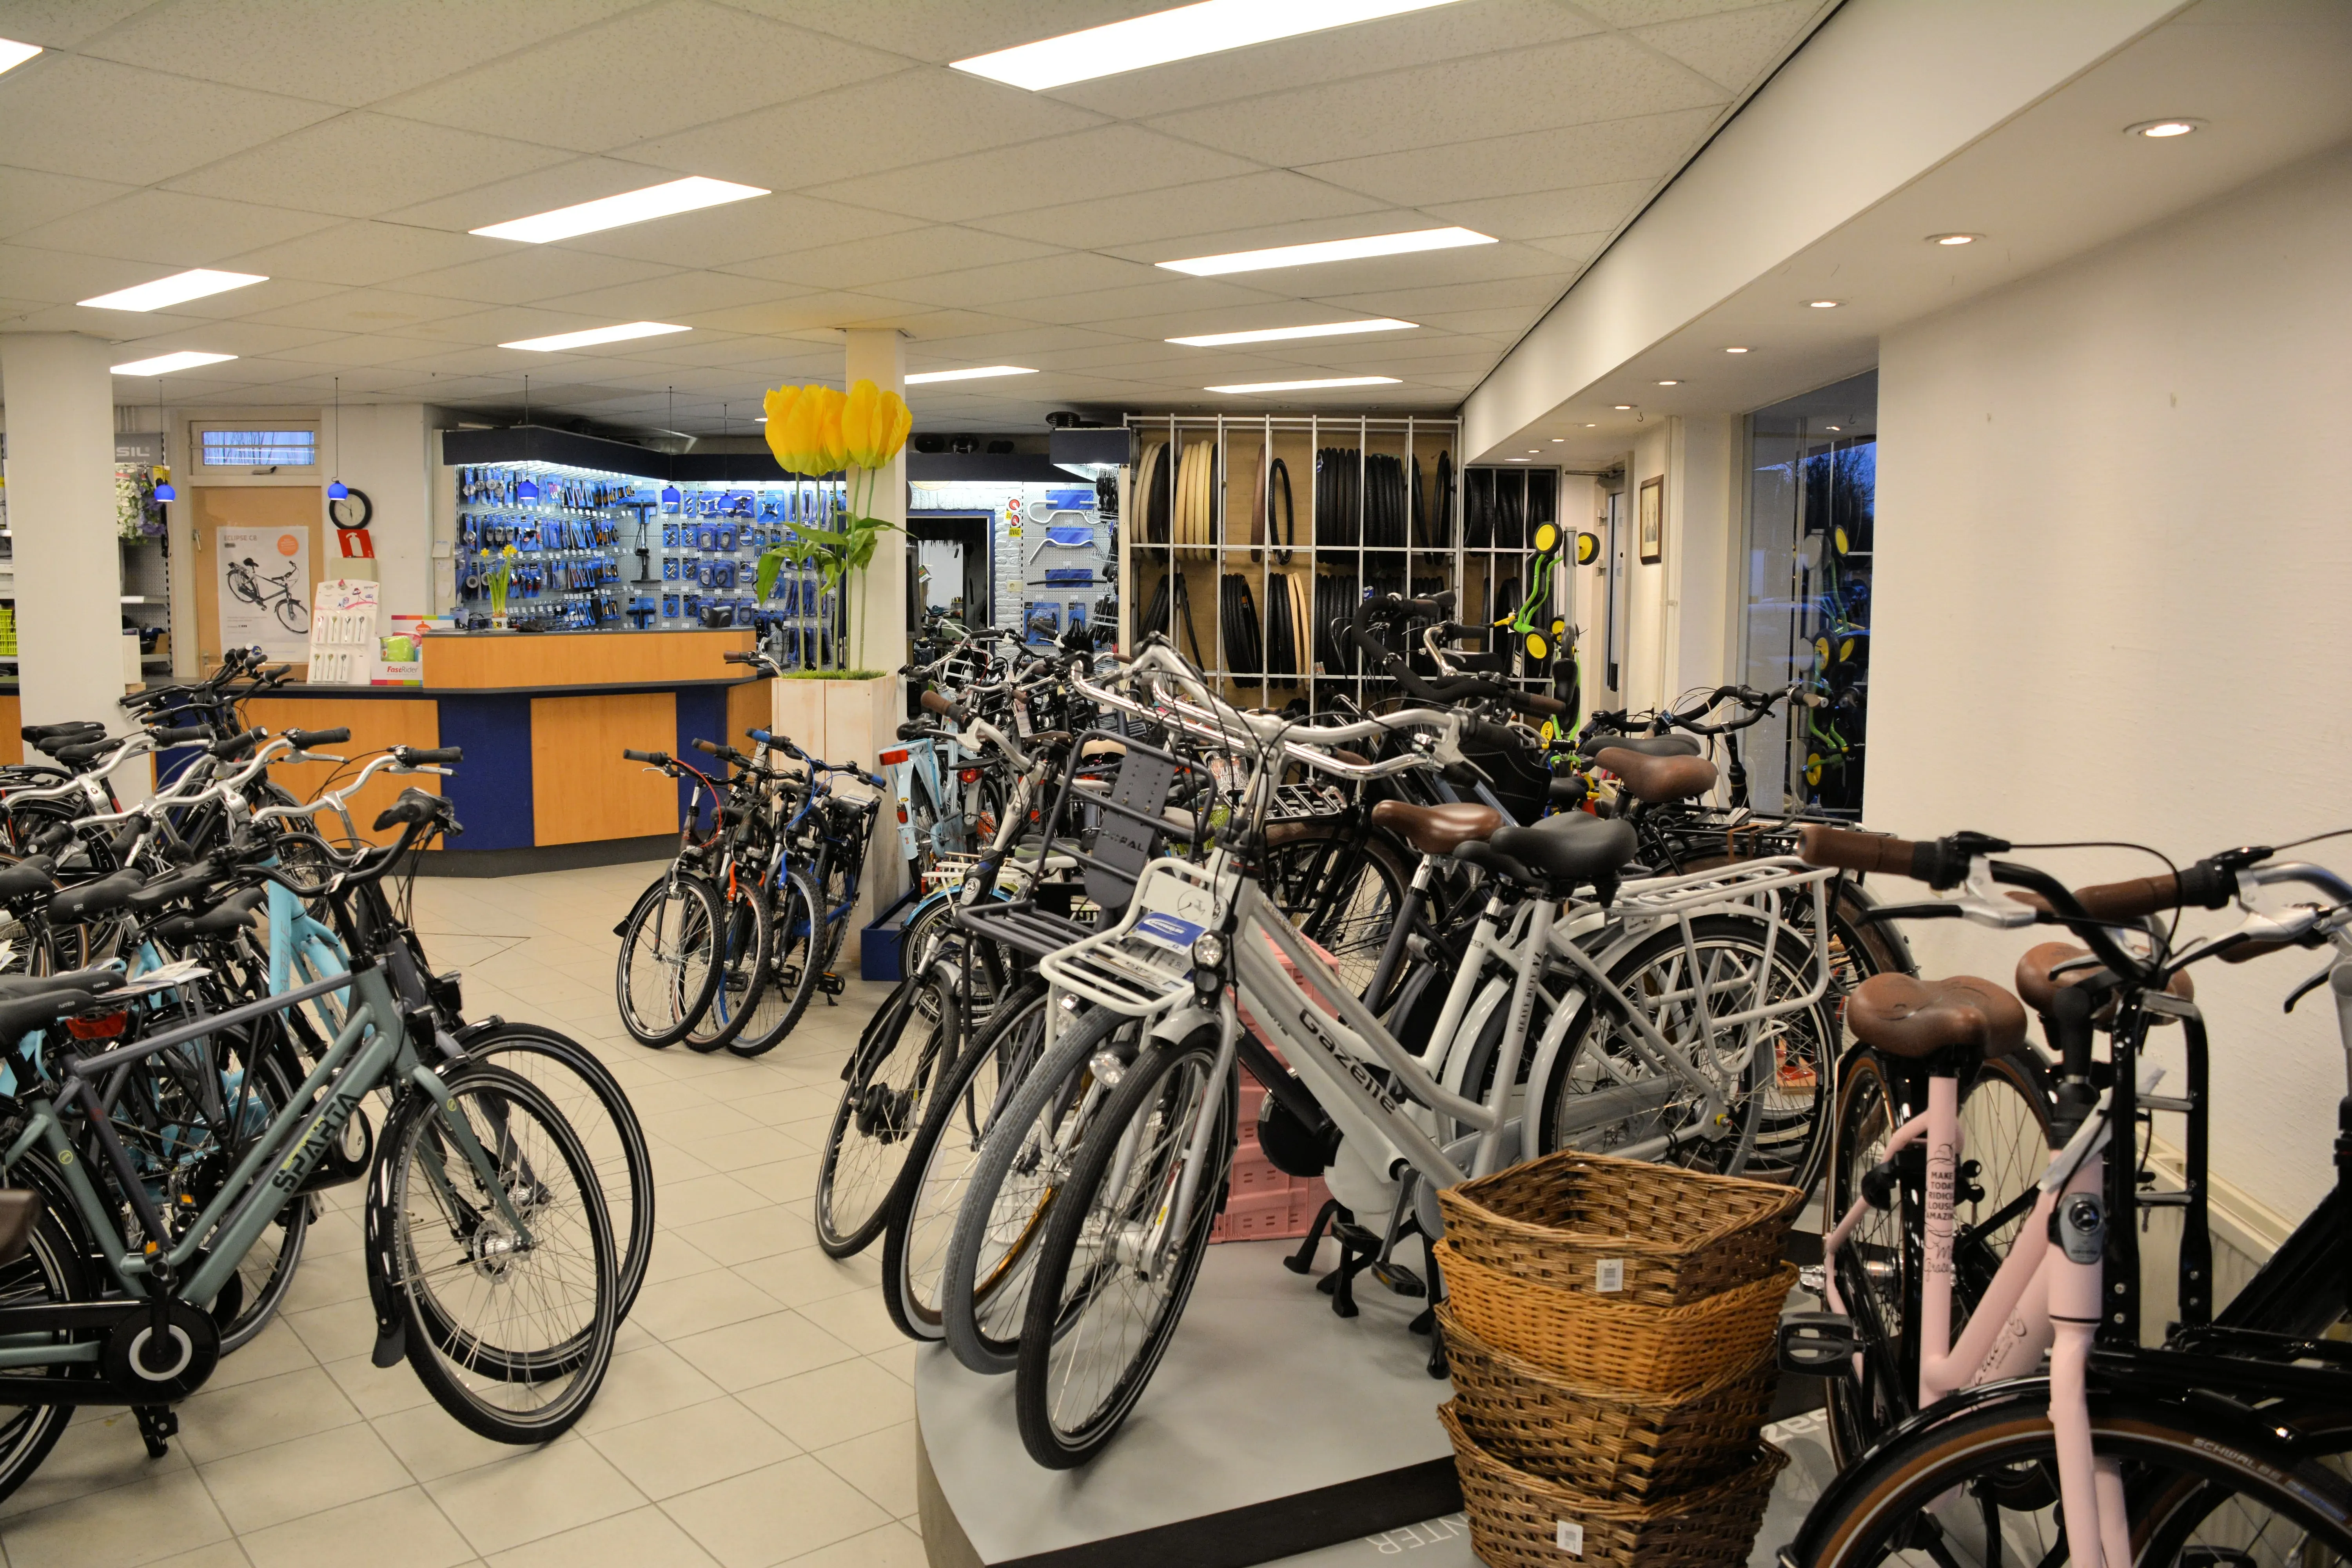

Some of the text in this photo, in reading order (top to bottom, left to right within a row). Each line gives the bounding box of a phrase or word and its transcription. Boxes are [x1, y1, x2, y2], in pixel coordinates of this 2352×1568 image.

[1299, 1009, 1396, 1115] Gazelle
[272, 1093, 361, 1194] SPARTA
[2193, 1437, 2282, 1481] SCHWALBE
